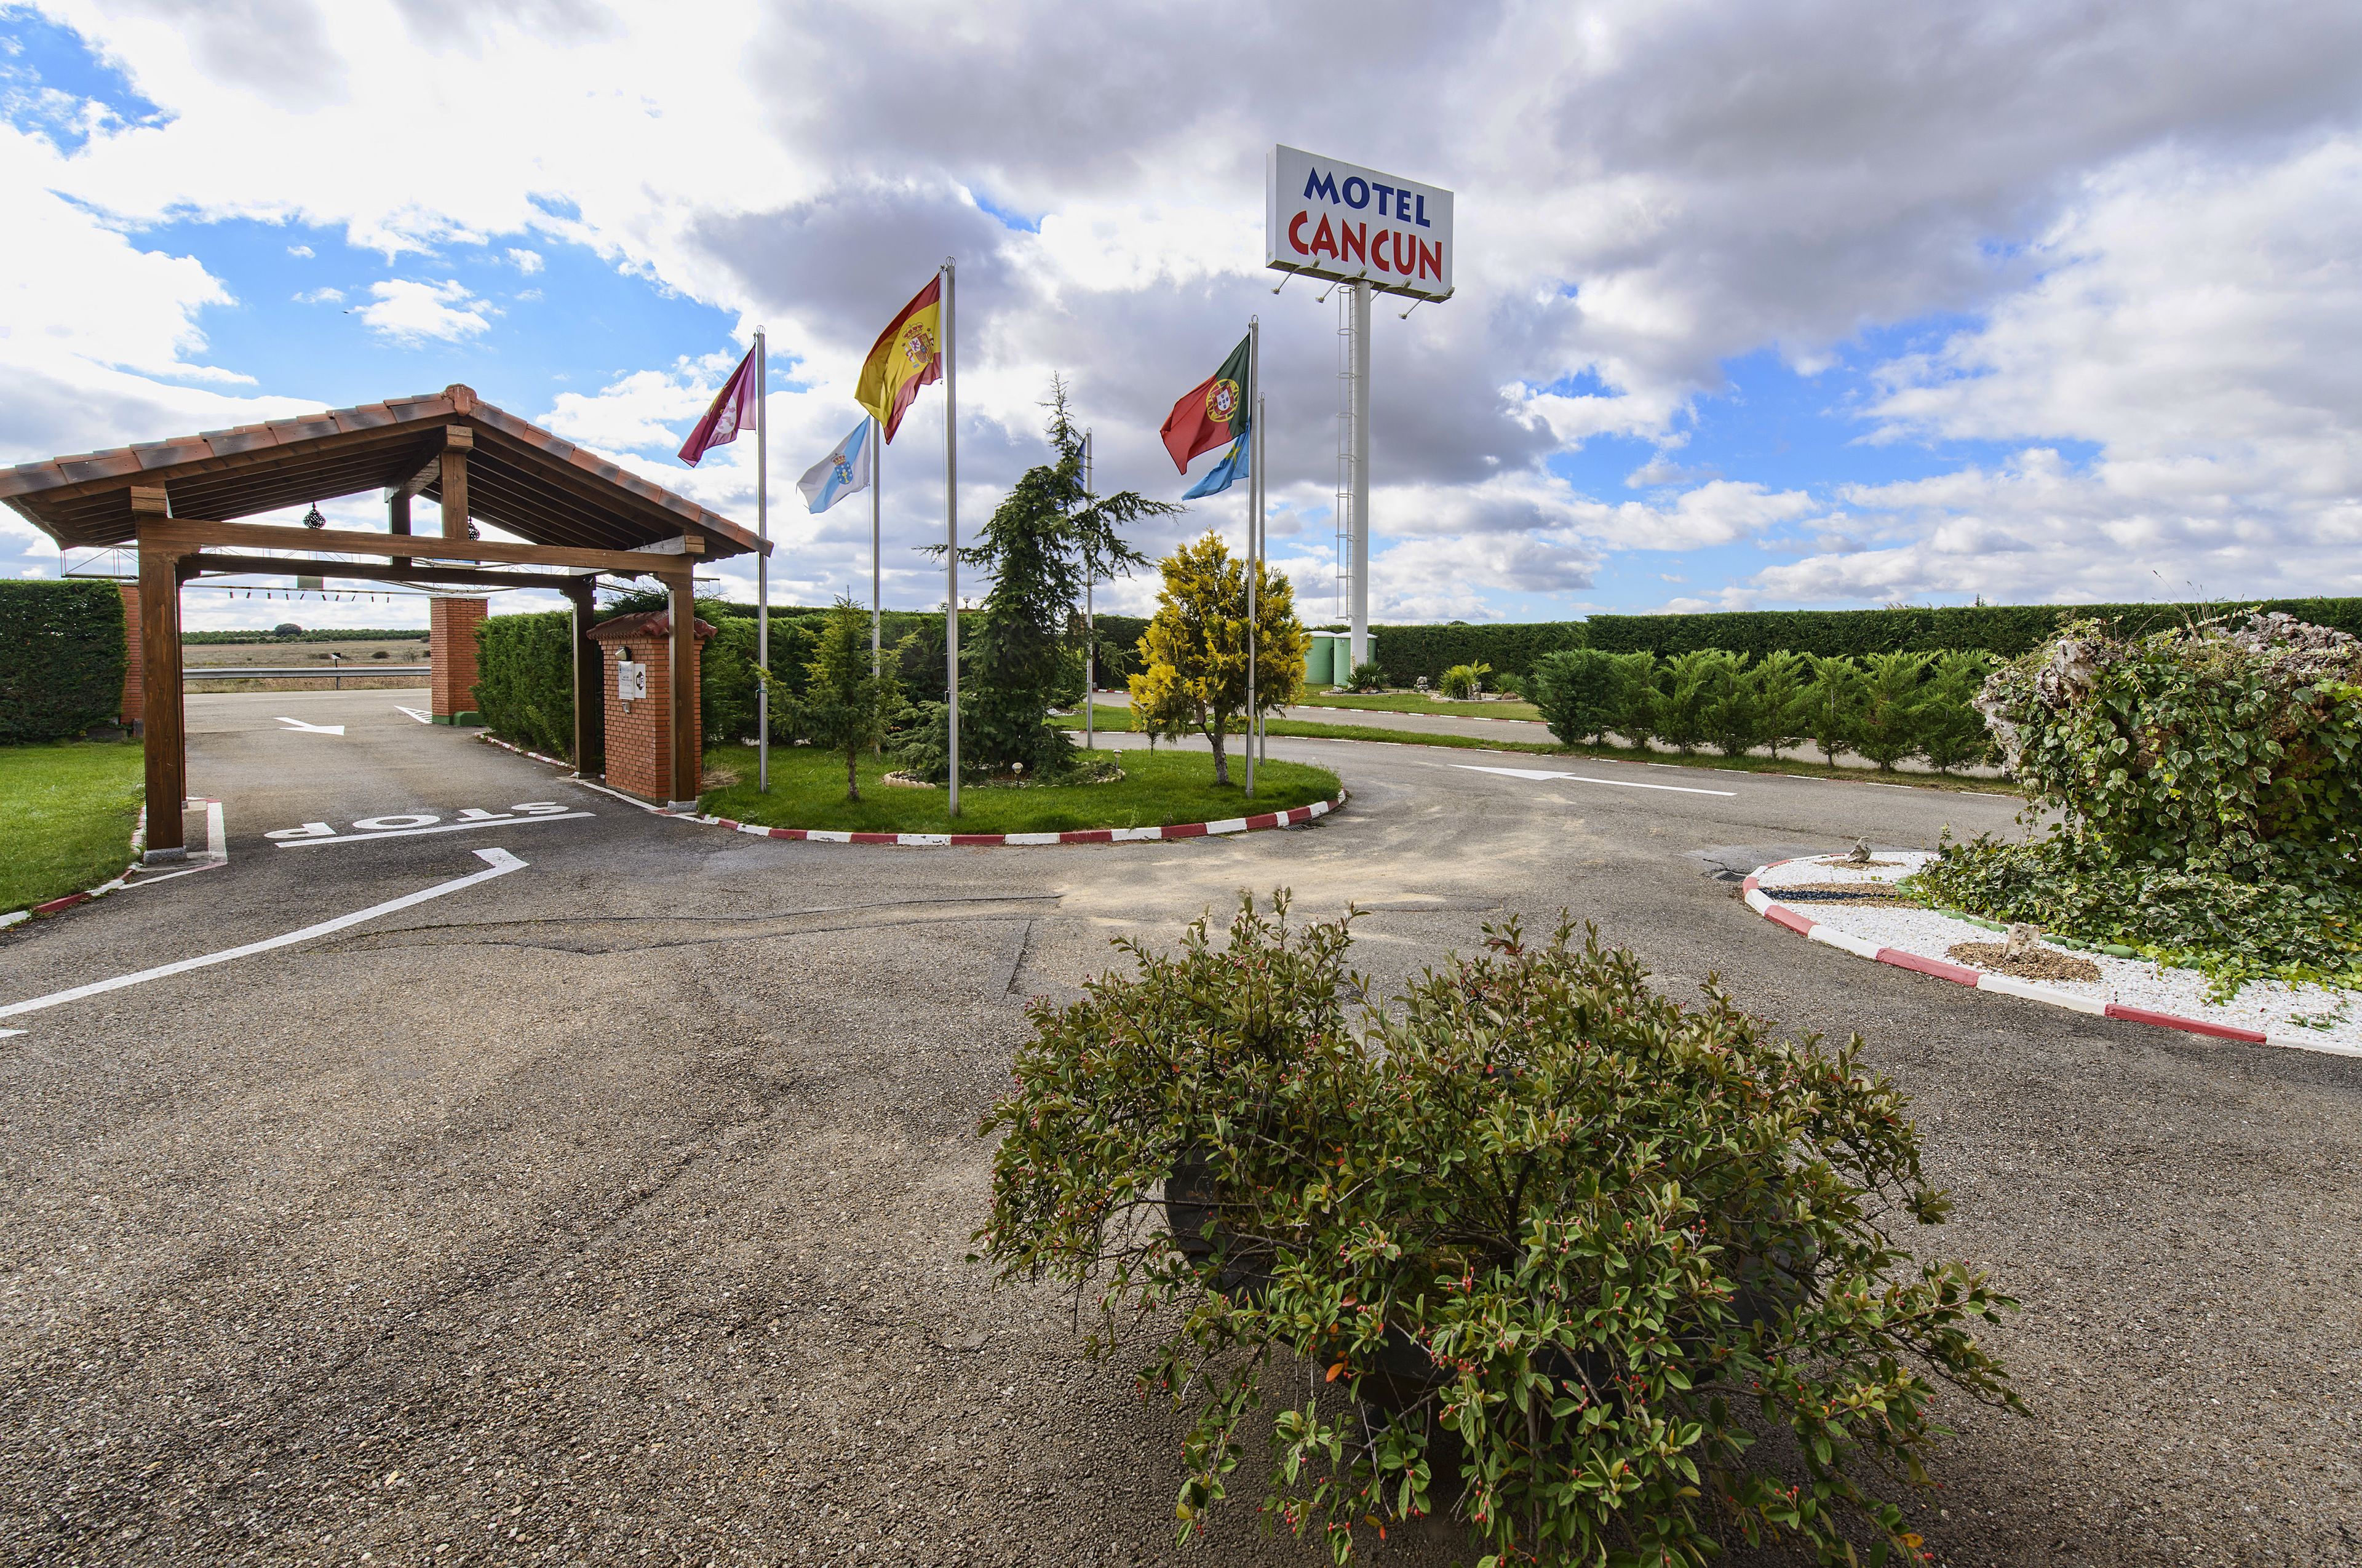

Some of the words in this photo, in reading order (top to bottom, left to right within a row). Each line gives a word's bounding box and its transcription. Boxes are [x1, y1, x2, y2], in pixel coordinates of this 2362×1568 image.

[1303, 167, 1431, 228] MOTEL
[1288, 210, 1442, 284] CANCUN
[263, 802, 570, 839] STOP
